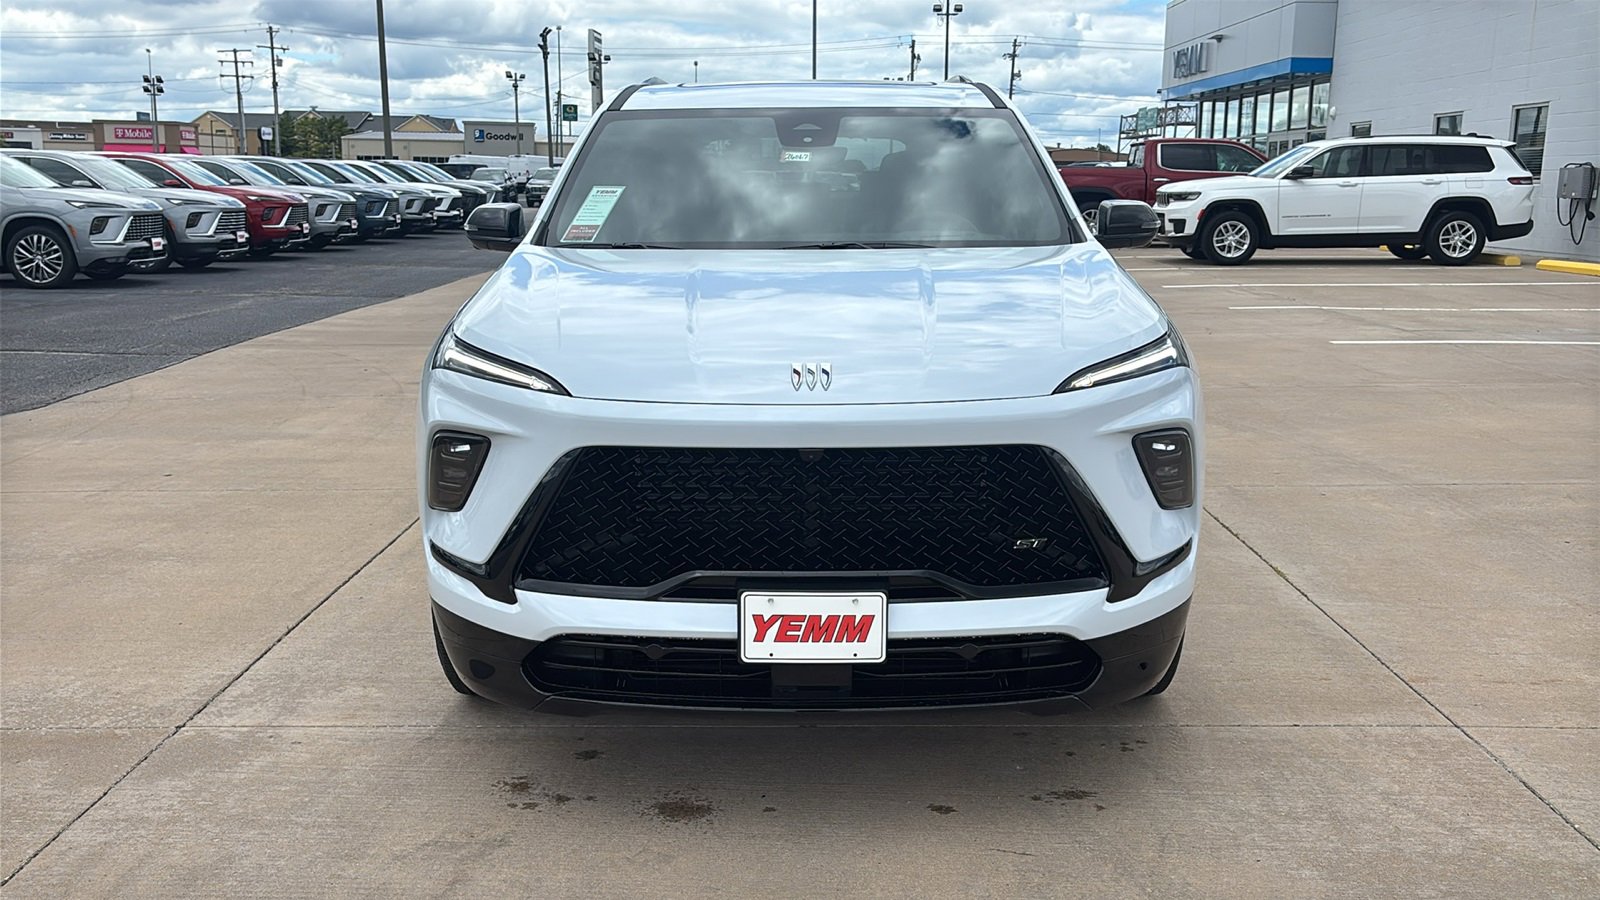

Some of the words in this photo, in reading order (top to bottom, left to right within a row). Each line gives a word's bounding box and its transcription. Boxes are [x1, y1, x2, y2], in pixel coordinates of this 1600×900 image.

[486, 132, 524, 141] Goodwll
[1013, 537, 1047, 550] ST
[752, 614, 876, 643] YEMM
